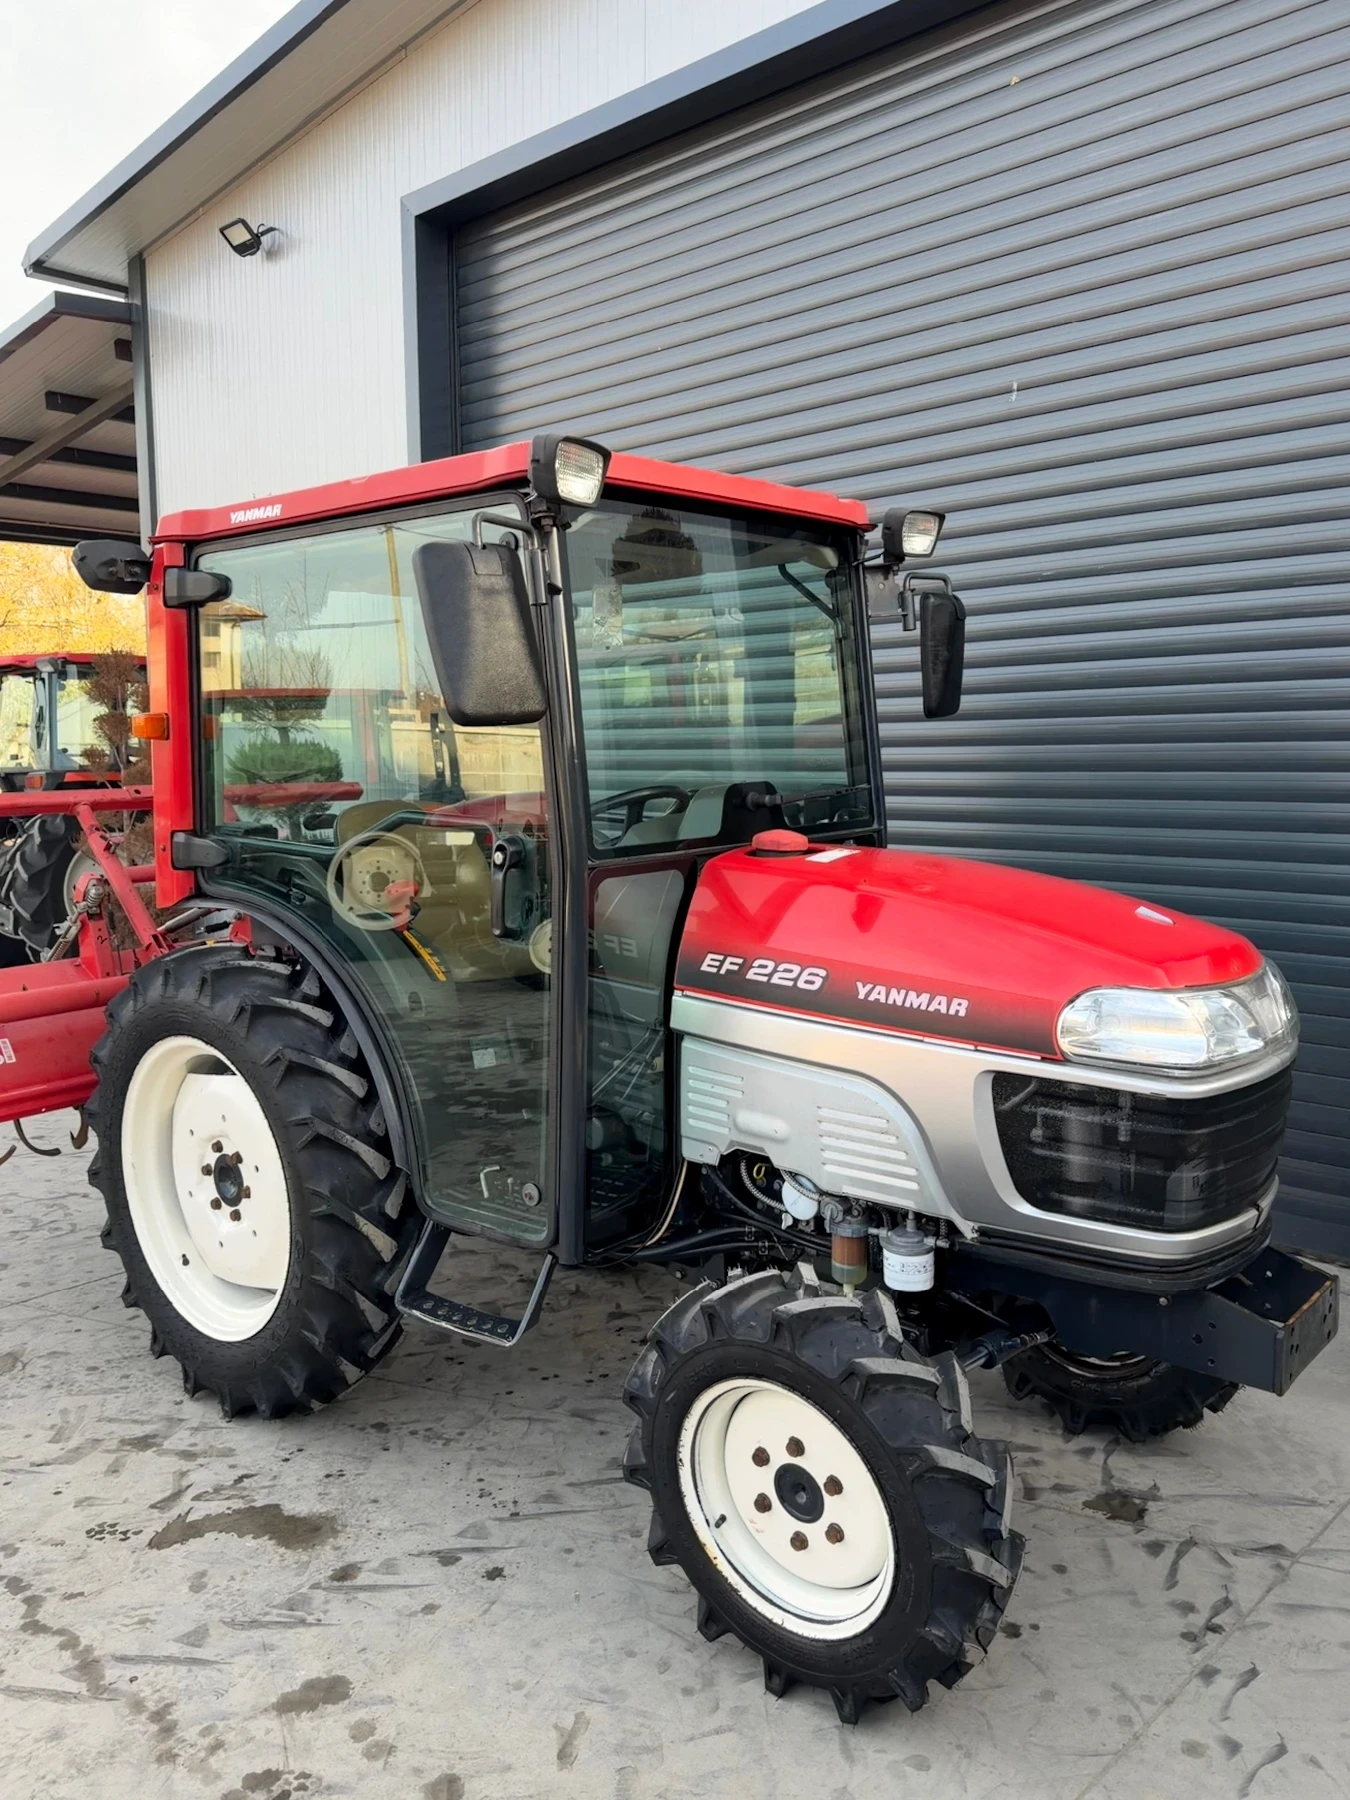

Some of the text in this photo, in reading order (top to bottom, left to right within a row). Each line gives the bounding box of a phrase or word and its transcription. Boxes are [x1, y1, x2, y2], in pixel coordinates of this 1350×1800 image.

[229, 503, 283, 525] YANMAR
[700, 952, 828, 991] EF 226
[855, 981, 970, 1017] YANMAR
